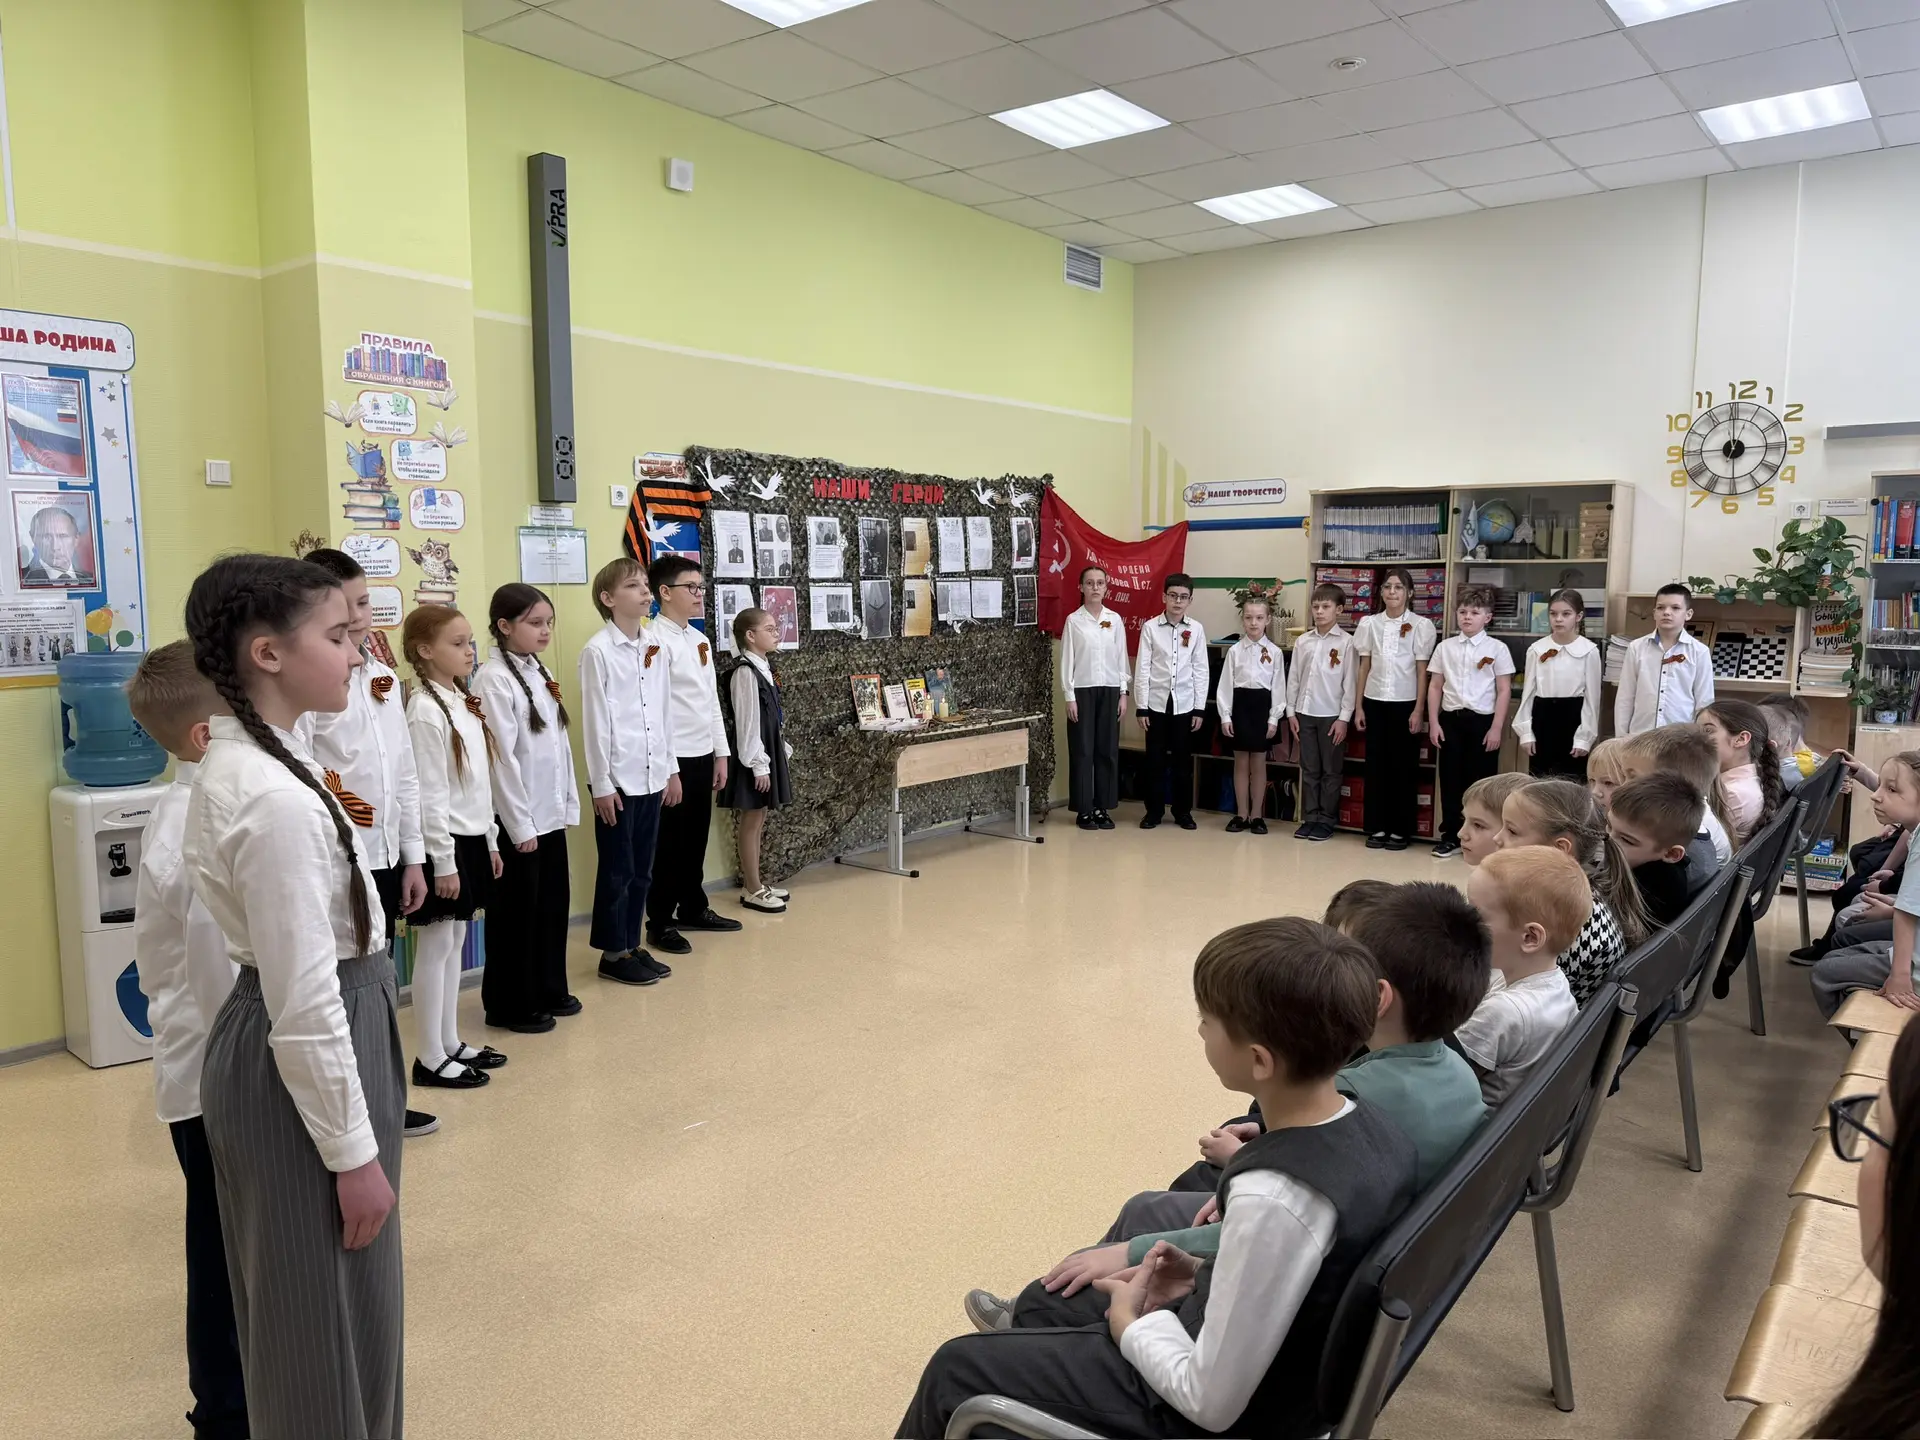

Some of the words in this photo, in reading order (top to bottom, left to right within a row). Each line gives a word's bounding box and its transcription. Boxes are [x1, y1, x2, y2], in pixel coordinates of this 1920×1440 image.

[34, 330, 117, 353] РОДИНА
[361, 333, 433, 354] ПРАВИЛА
[350, 371, 404, 385] ОБРАЩЕНИЯ
[412, 378, 445, 389] КНИГОЙ
[1729, 380, 1758, 400] 12
[1766, 386, 1774, 404] 1
[1695, 391, 1713, 408] 11
[1783, 404, 1804, 421] 2
[1666, 413, 1691, 432] 10
[1666, 445, 1683, 464] 9
[1786, 436, 1805, 455] 3
[1670, 469, 1688, 487] 8
[1778, 465, 1796, 483] 4
[813, 477, 870, 500] НАШИ
[892, 483, 945, 504] ГЕРОИ
[1207, 490, 1232, 498] НАШЕ
[1232, 487, 1283, 497] ТВОРЧЕСТВО
[1689, 490, 1711, 508] 7
[1757, 487, 1775, 506] 5
[1721, 496, 1739, 514] 6
